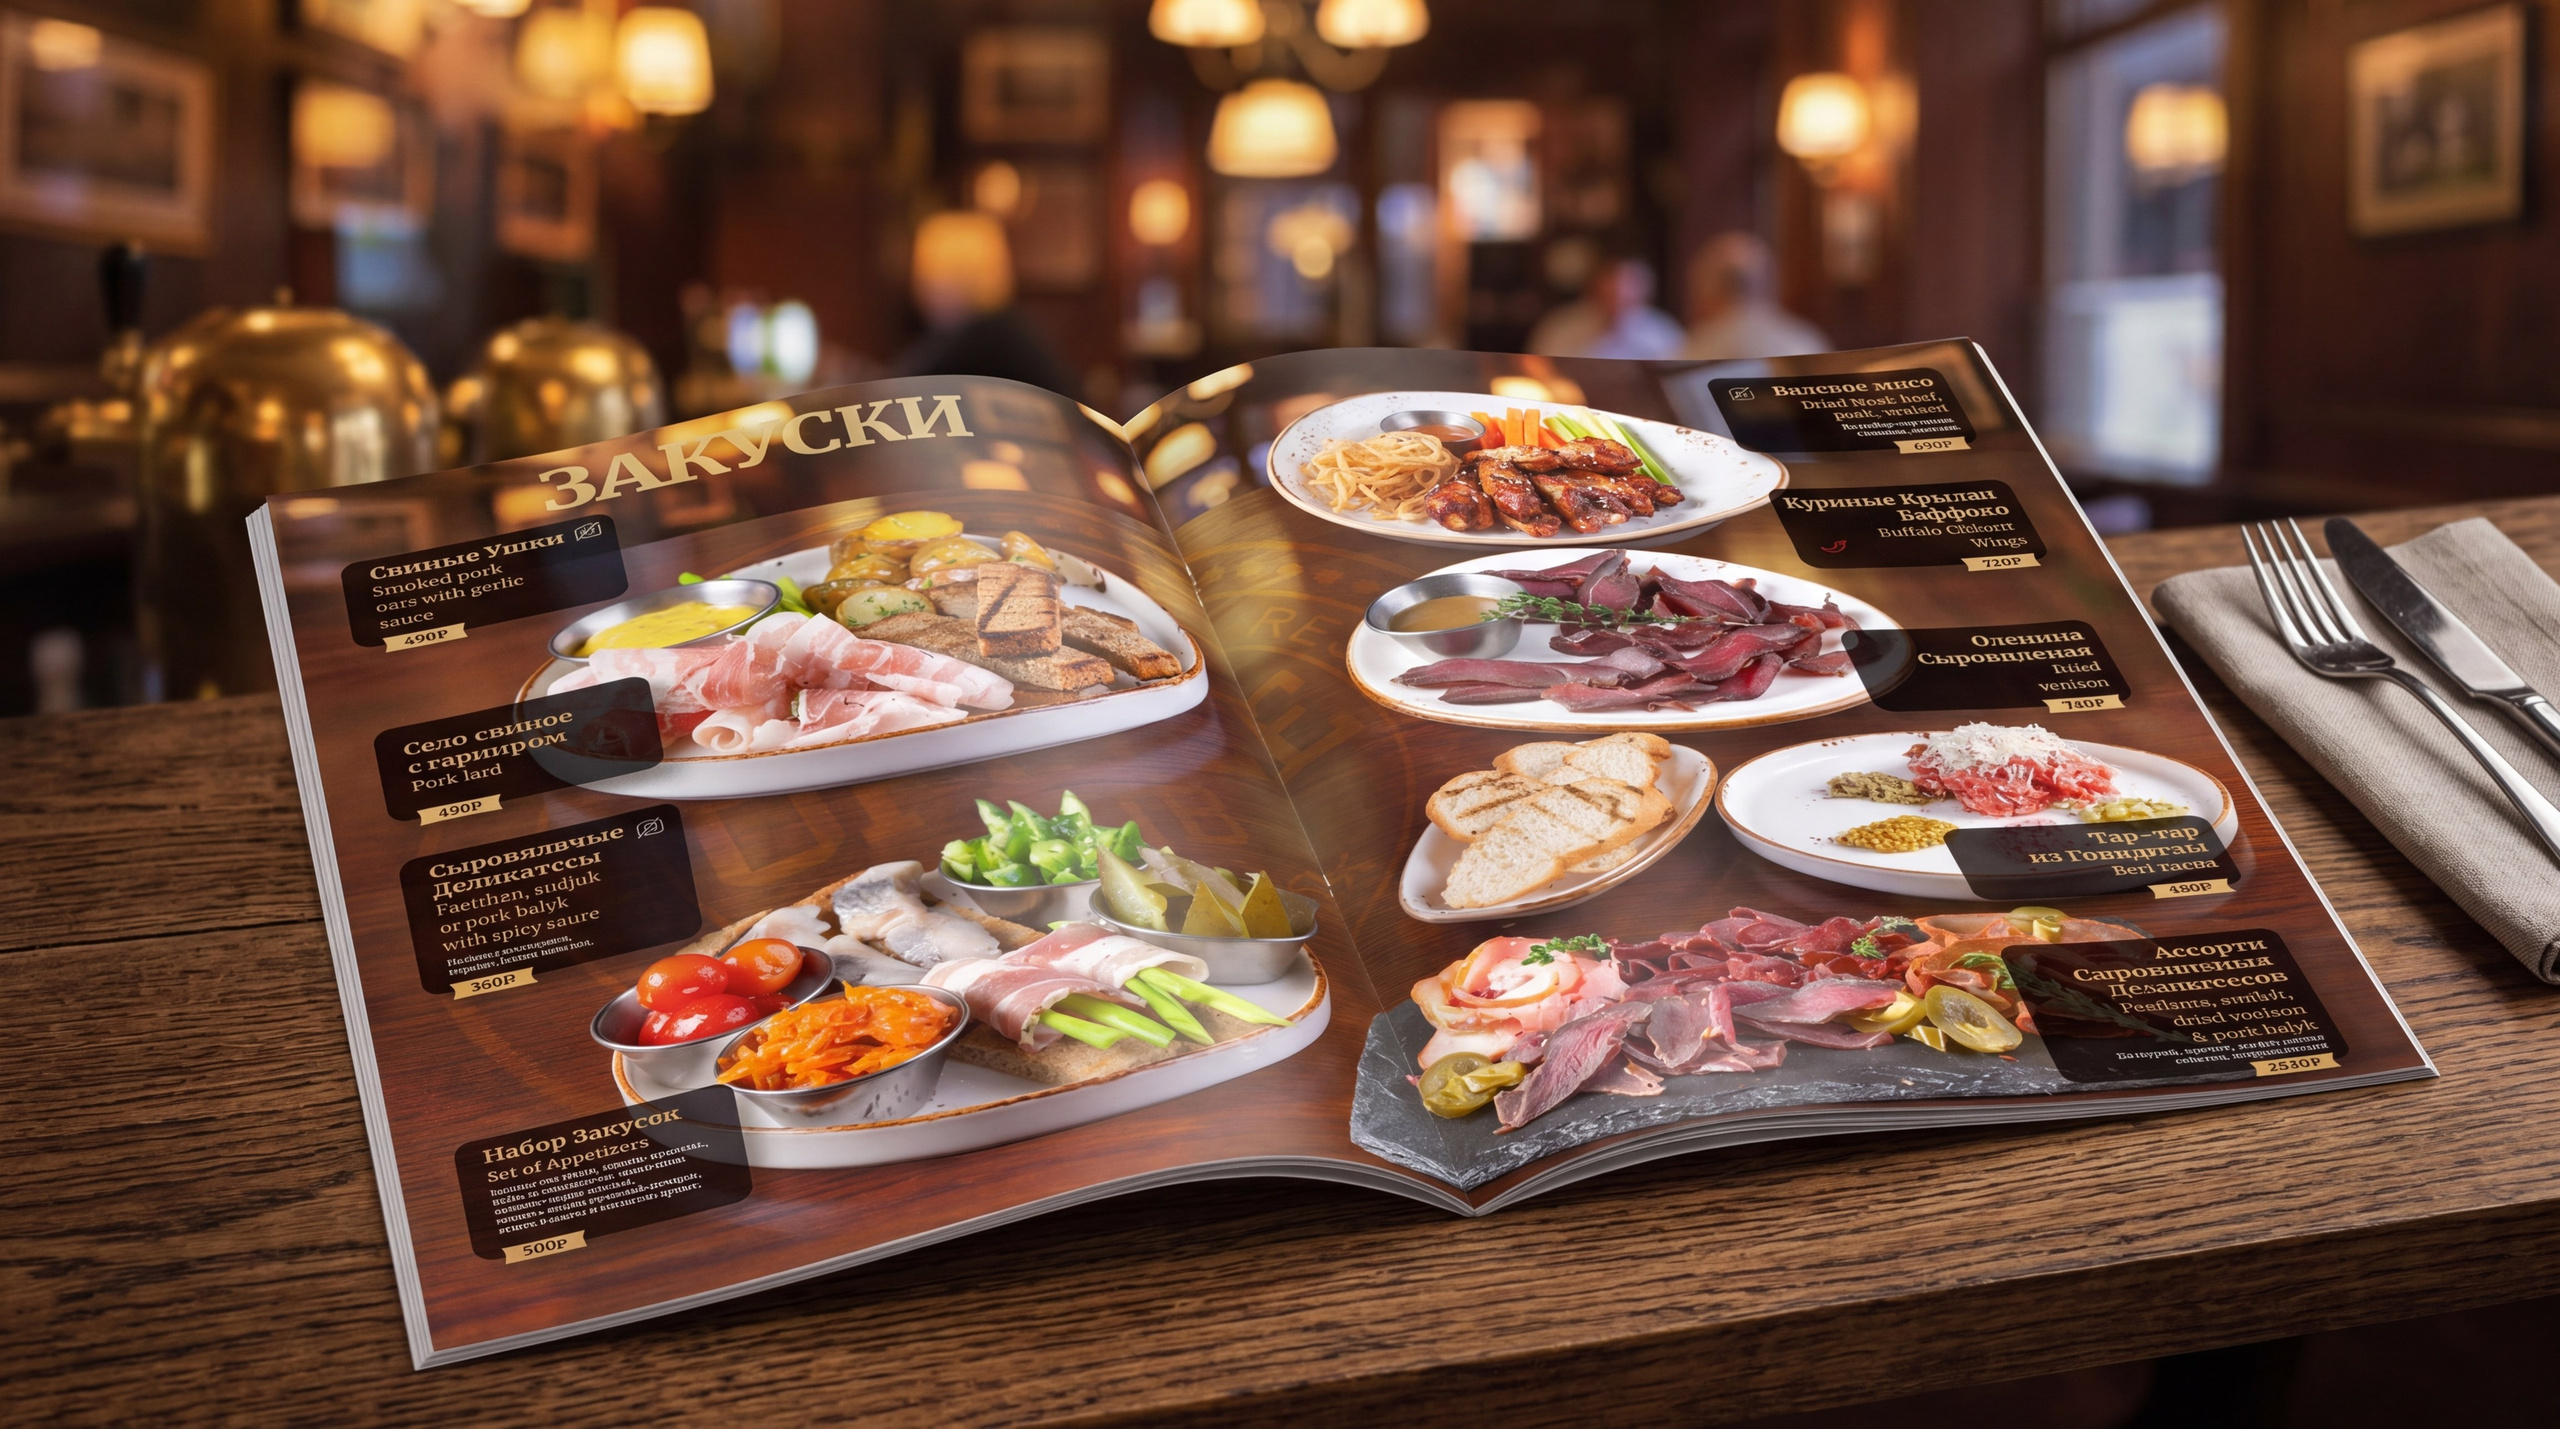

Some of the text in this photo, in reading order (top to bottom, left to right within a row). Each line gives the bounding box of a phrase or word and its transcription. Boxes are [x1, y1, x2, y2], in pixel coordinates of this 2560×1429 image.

[539, 395, 974, 511] ЗАКУСКИ
[1782, 496, 1896, 512] Куриные
[1877, 526, 1942, 540] Buffalo
[1970, 536, 2028, 550] Wings
[370, 533, 565, 580] Свиные Ушки
[372, 563, 503, 598] Smoked pork
[376, 576, 525, 613] oars with gerlic
[379, 611, 434, 630] sauce
[1971, 630, 2085, 647] Оленина
[2038, 678, 2110, 692] venison
[403, 712, 573, 756] Село свиное
[408, 763, 422, 774] с
[411, 763, 503, 792] Pork lard
[2087, 827, 2199, 846] Тар-тар
[2028, 852, 2063, 864] из
[534, 871, 601, 896] sudjuk
[440, 896, 570, 934] or pork balyk
[442, 933, 487, 952] with
[492, 922, 541, 945] spicy
[2155, 939, 2268, 960] Ассорти
[2191, 1031, 2208, 1043] &
[482, 1135, 566, 1165] Набор
[487, 1138, 650, 1183] Set of Appetizers
